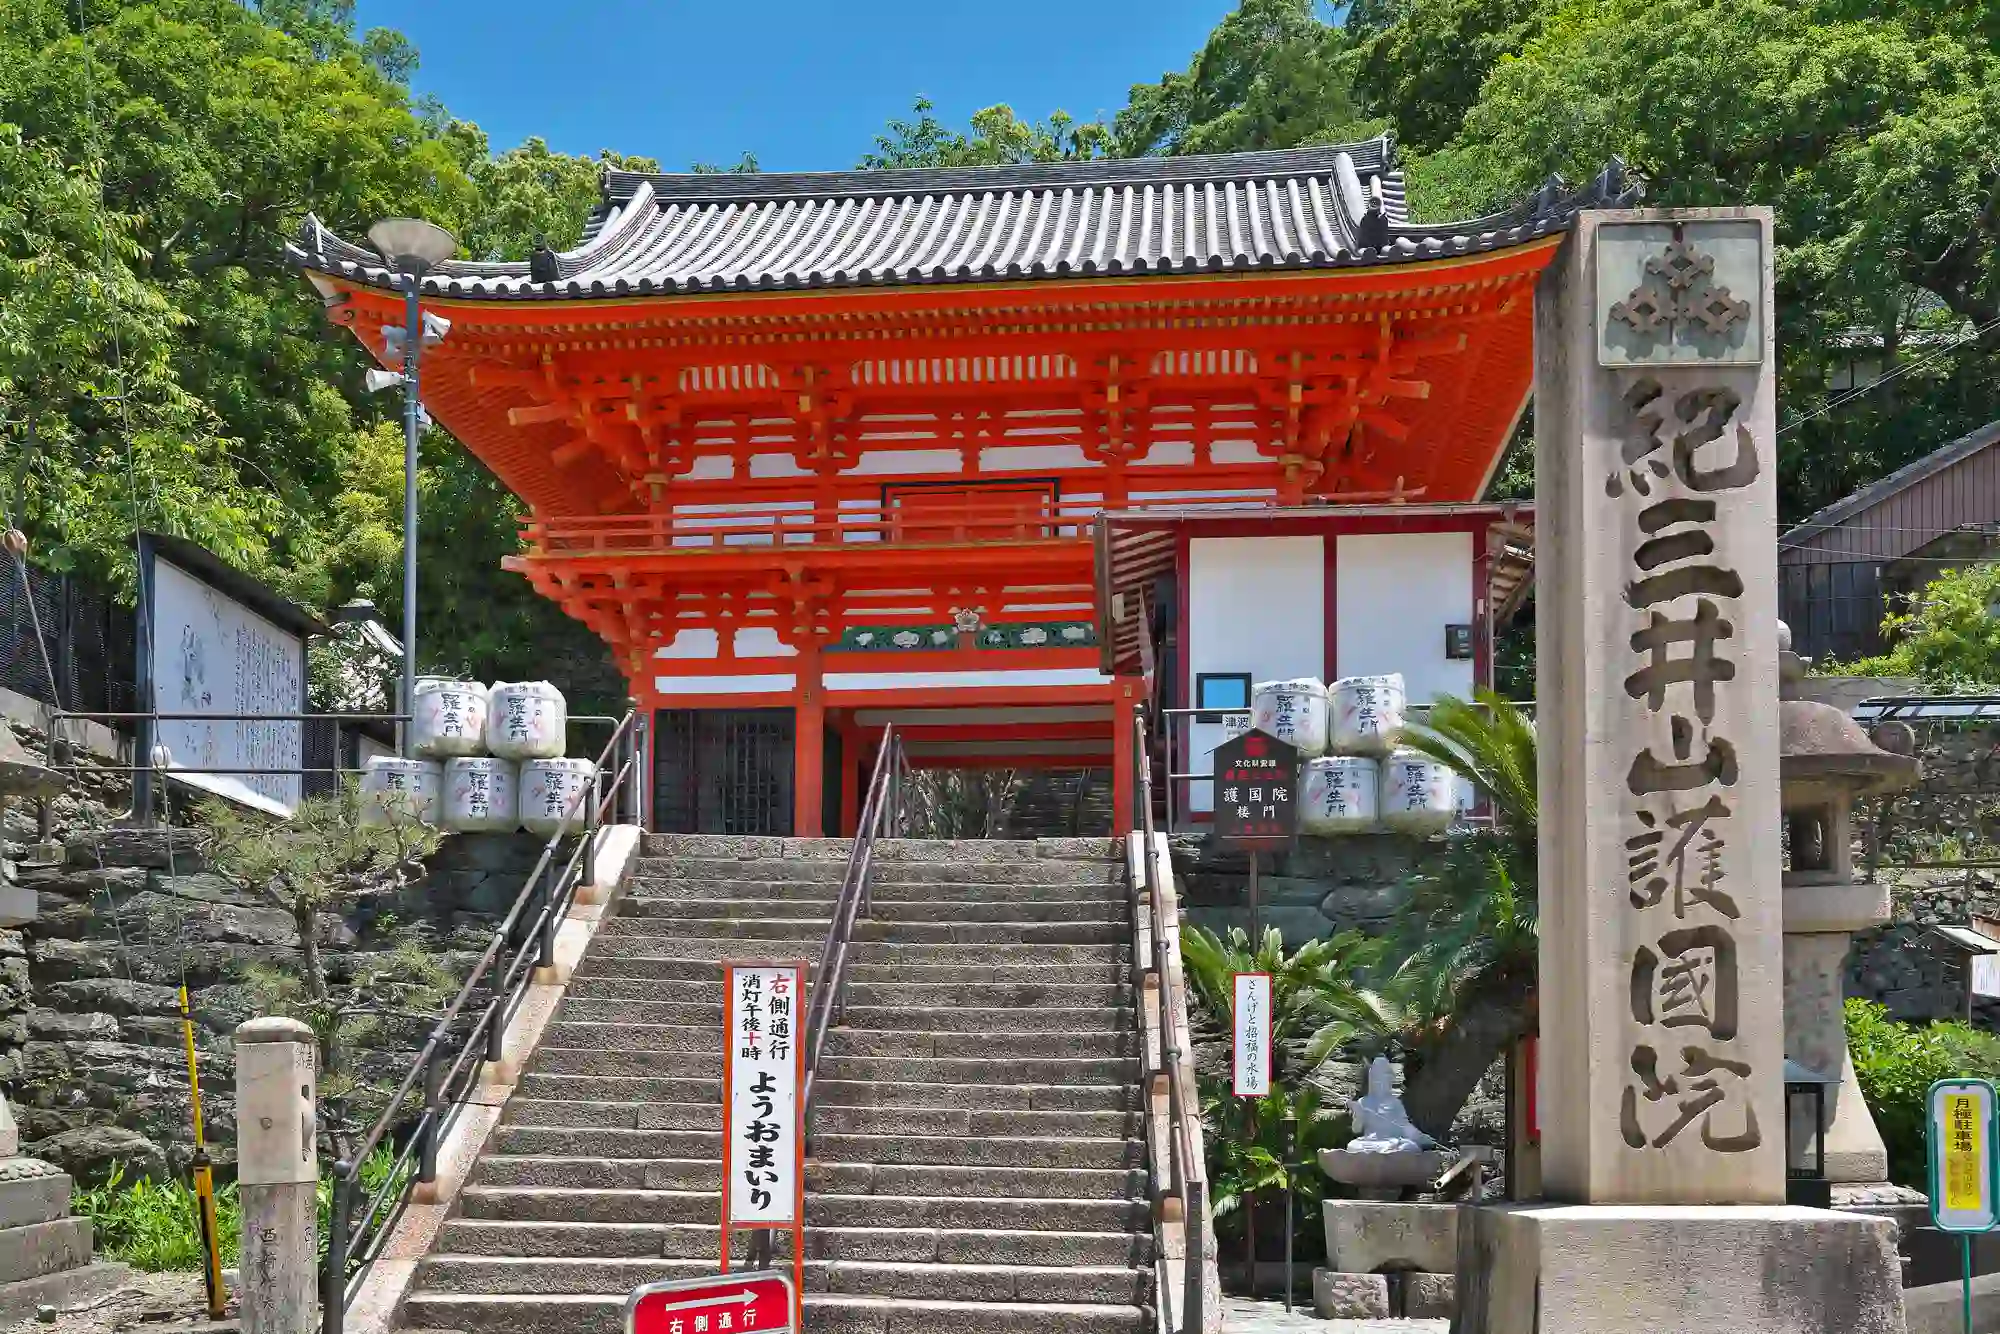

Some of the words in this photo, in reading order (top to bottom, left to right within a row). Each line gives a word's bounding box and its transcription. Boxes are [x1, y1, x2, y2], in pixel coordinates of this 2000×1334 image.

[440, 692, 463, 737] 羅生門
[507, 696, 529, 742] 羅生門
[1225, 716, 1249, 729] 津波
[1606, 376, 1763, 1154] 紀三井山護國院
[469, 772, 489, 818] 羅生門
[544, 771, 565, 818] 羅生門
[1223, 787, 1288, 803] 護国院
[1236, 805, 1276, 819] 楼門
[741, 974, 763, 1061] 消灯午後十時
[768, 973, 790, 1061] 右側通行
[743, 1071, 781, 1211] ようおまいり
[1954, 1098, 1972, 1152] 月極駐車場
[669, 1308, 757, 1334] 右側通行
